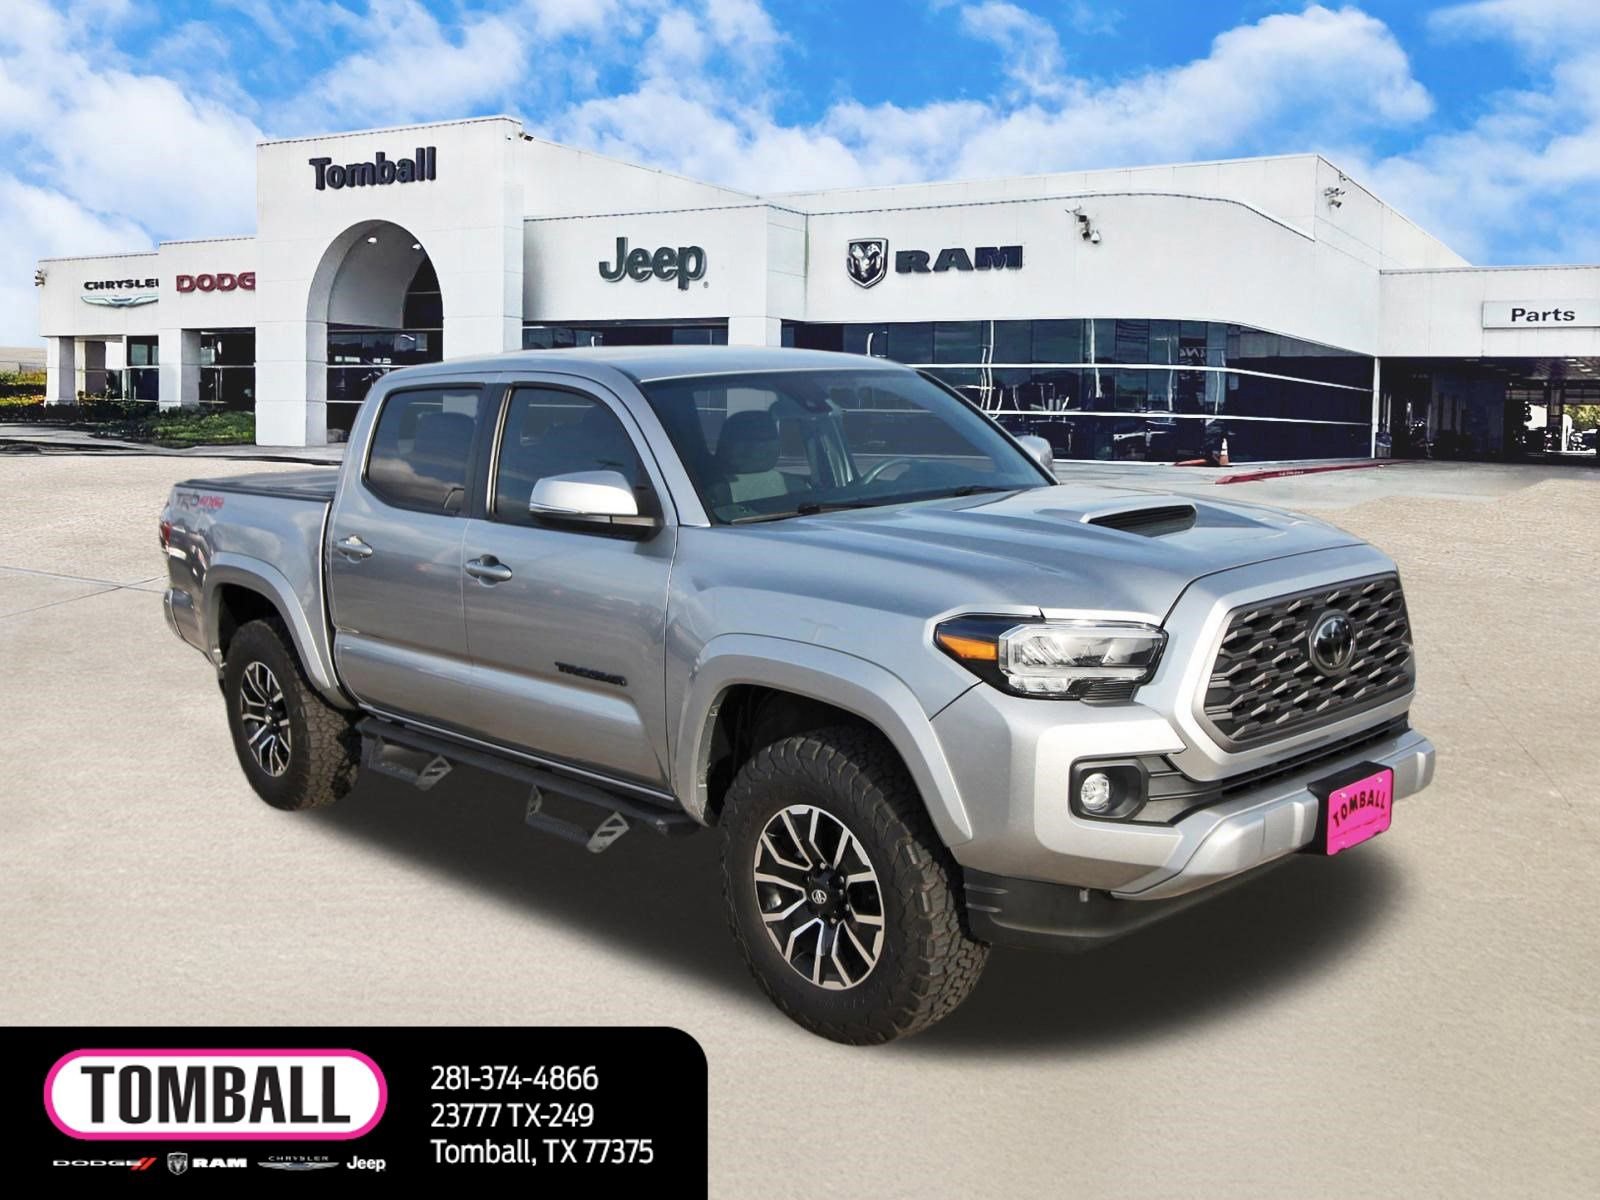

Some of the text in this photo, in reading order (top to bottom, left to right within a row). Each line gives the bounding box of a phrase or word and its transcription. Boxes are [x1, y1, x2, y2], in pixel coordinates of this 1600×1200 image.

[308, 147, 437, 191] Tomball
[598, 236, 707, 291] Jeep
[895, 245, 1024, 274] RAM
[176, 271, 256, 293] DODG
[1511, 306, 1576, 323] Parts
[1332, 789, 1386, 828] TOMBALL
